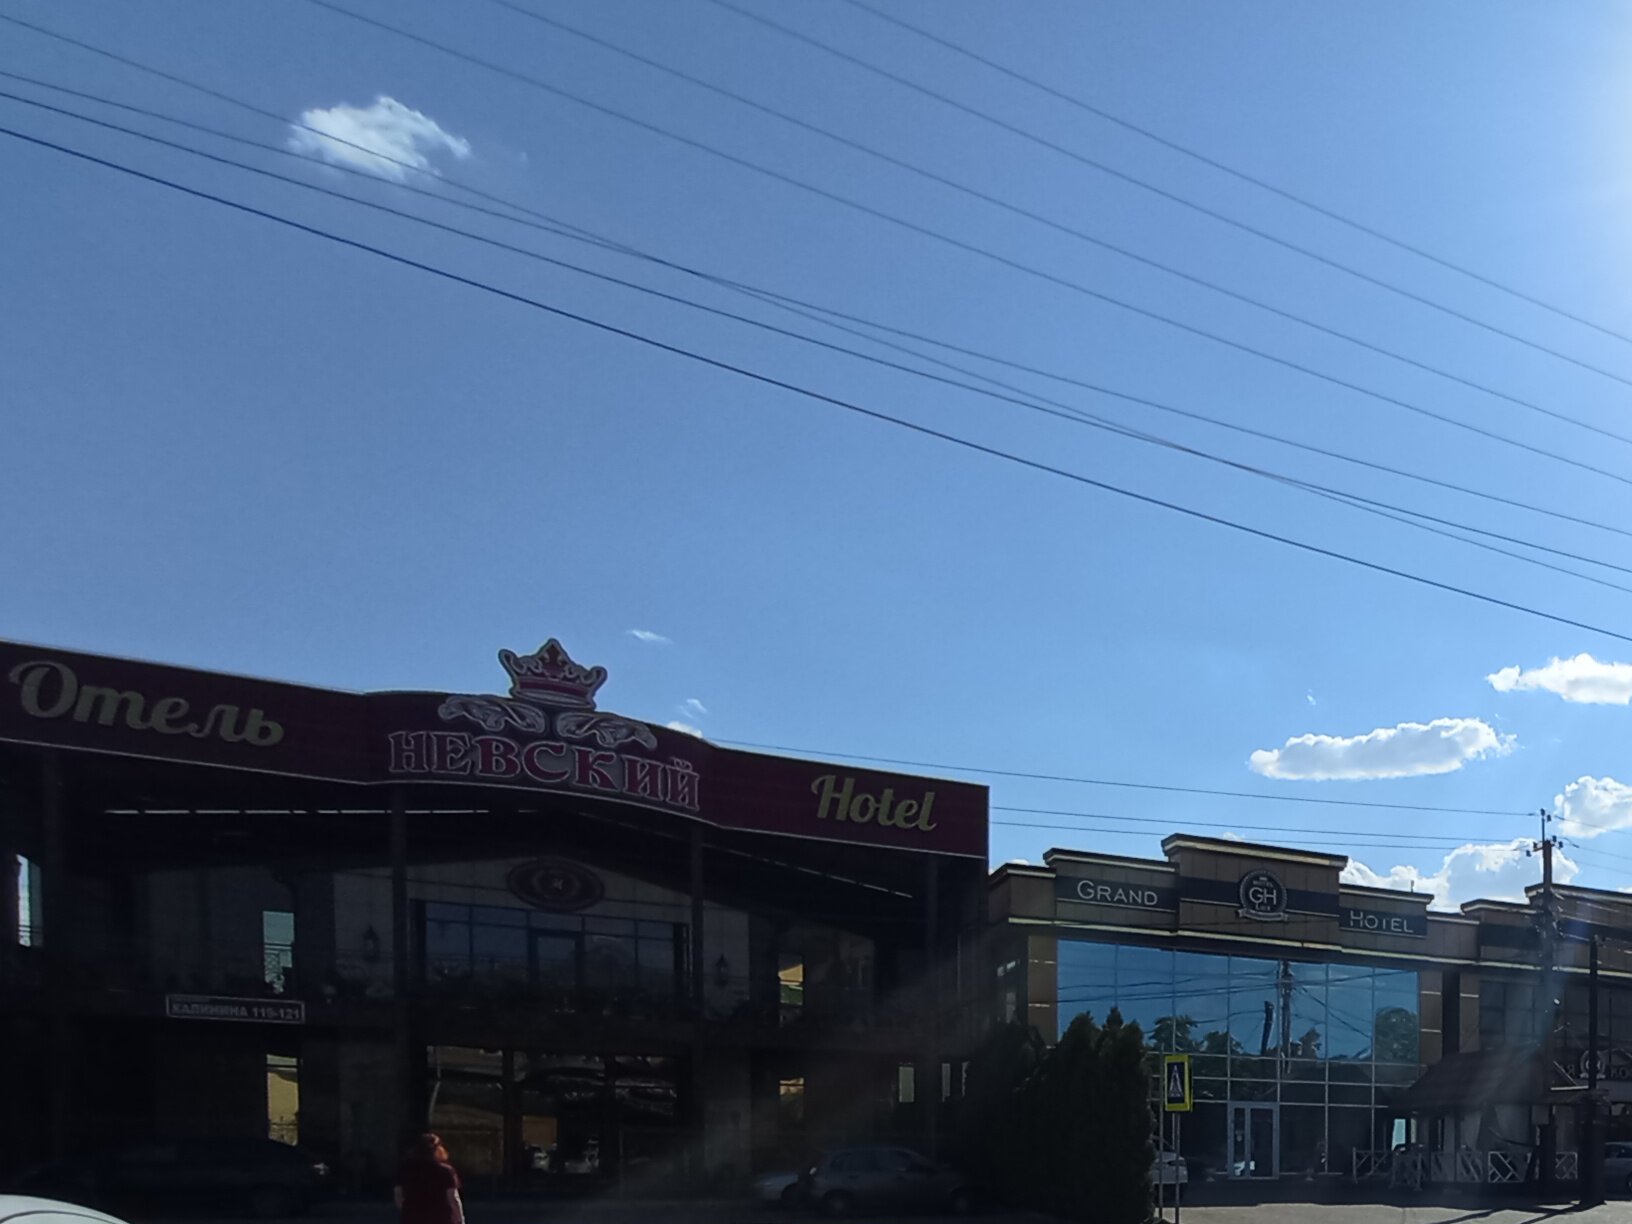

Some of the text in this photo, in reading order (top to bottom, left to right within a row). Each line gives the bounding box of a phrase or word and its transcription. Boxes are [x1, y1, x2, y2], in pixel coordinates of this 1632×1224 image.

[10, 662, 284, 745] Отель
[389, 731, 700, 811] НЕВСКИЙ
[812, 776, 937, 831] Hotel
[1077, 880, 1158, 906] GRAND
[1249, 887, 1277, 905] GH
[1350, 911, 1413, 933] HOTEL
